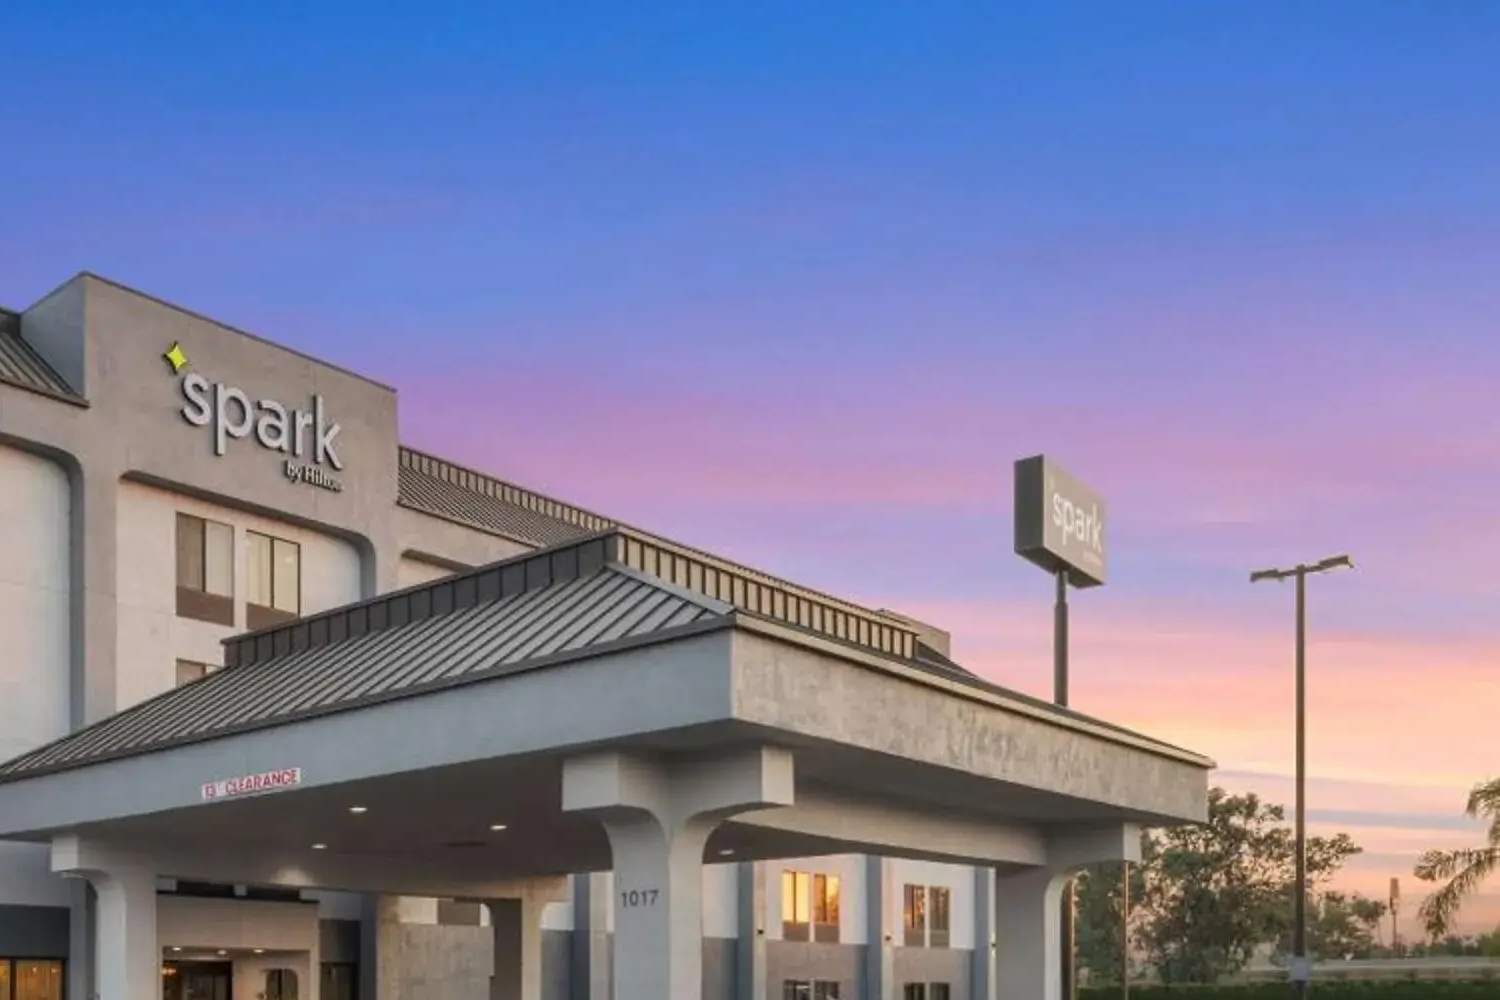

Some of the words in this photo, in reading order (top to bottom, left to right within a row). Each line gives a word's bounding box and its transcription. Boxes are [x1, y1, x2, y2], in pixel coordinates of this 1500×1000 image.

[181, 372, 343, 471] spark
[285, 460, 302, 483] by
[1052, 492, 1102, 553] spark
[225, 768, 298, 796] CLEARANCE
[622, 888, 659, 908] 1017
